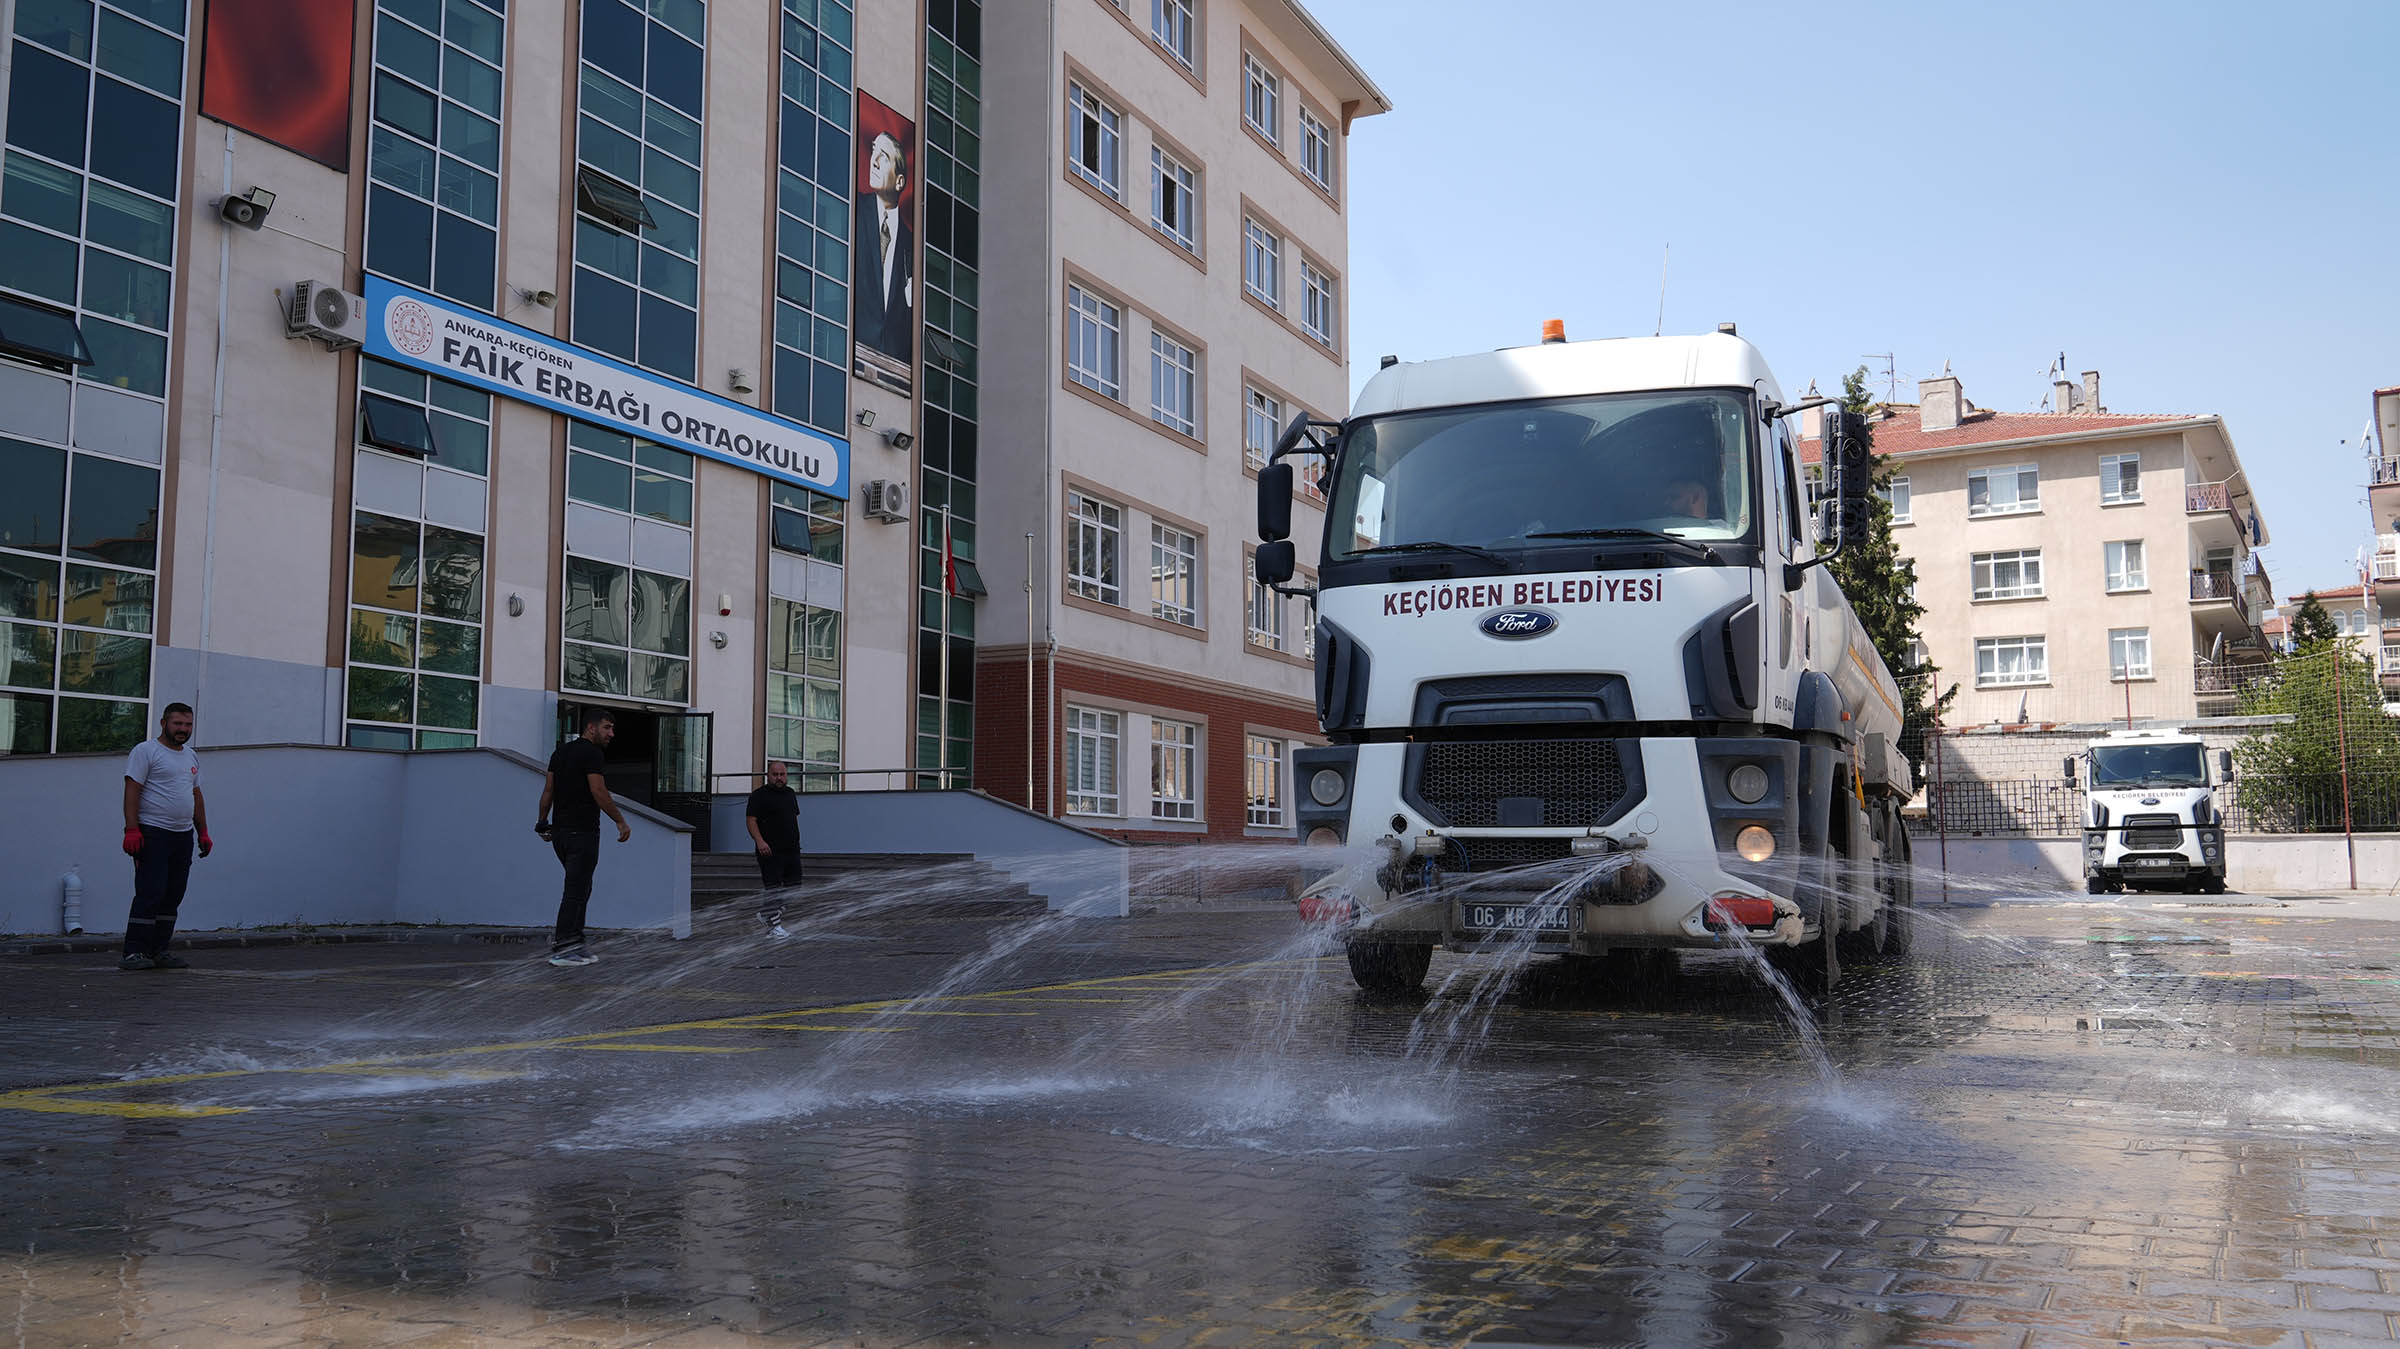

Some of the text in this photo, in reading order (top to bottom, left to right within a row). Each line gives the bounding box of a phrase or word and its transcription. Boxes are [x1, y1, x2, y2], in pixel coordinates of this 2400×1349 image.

[445, 319, 573, 370] ANKARA-KEÇİÖREN
[443, 337, 820, 479] FAİK ERBAĞI ORTAOKULU
[1384, 573, 1662, 617] KEÇİÖREN BELEDİYESİ
[1495, 613, 1538, 631] Ford
[1474, 906, 1494, 926] 06
